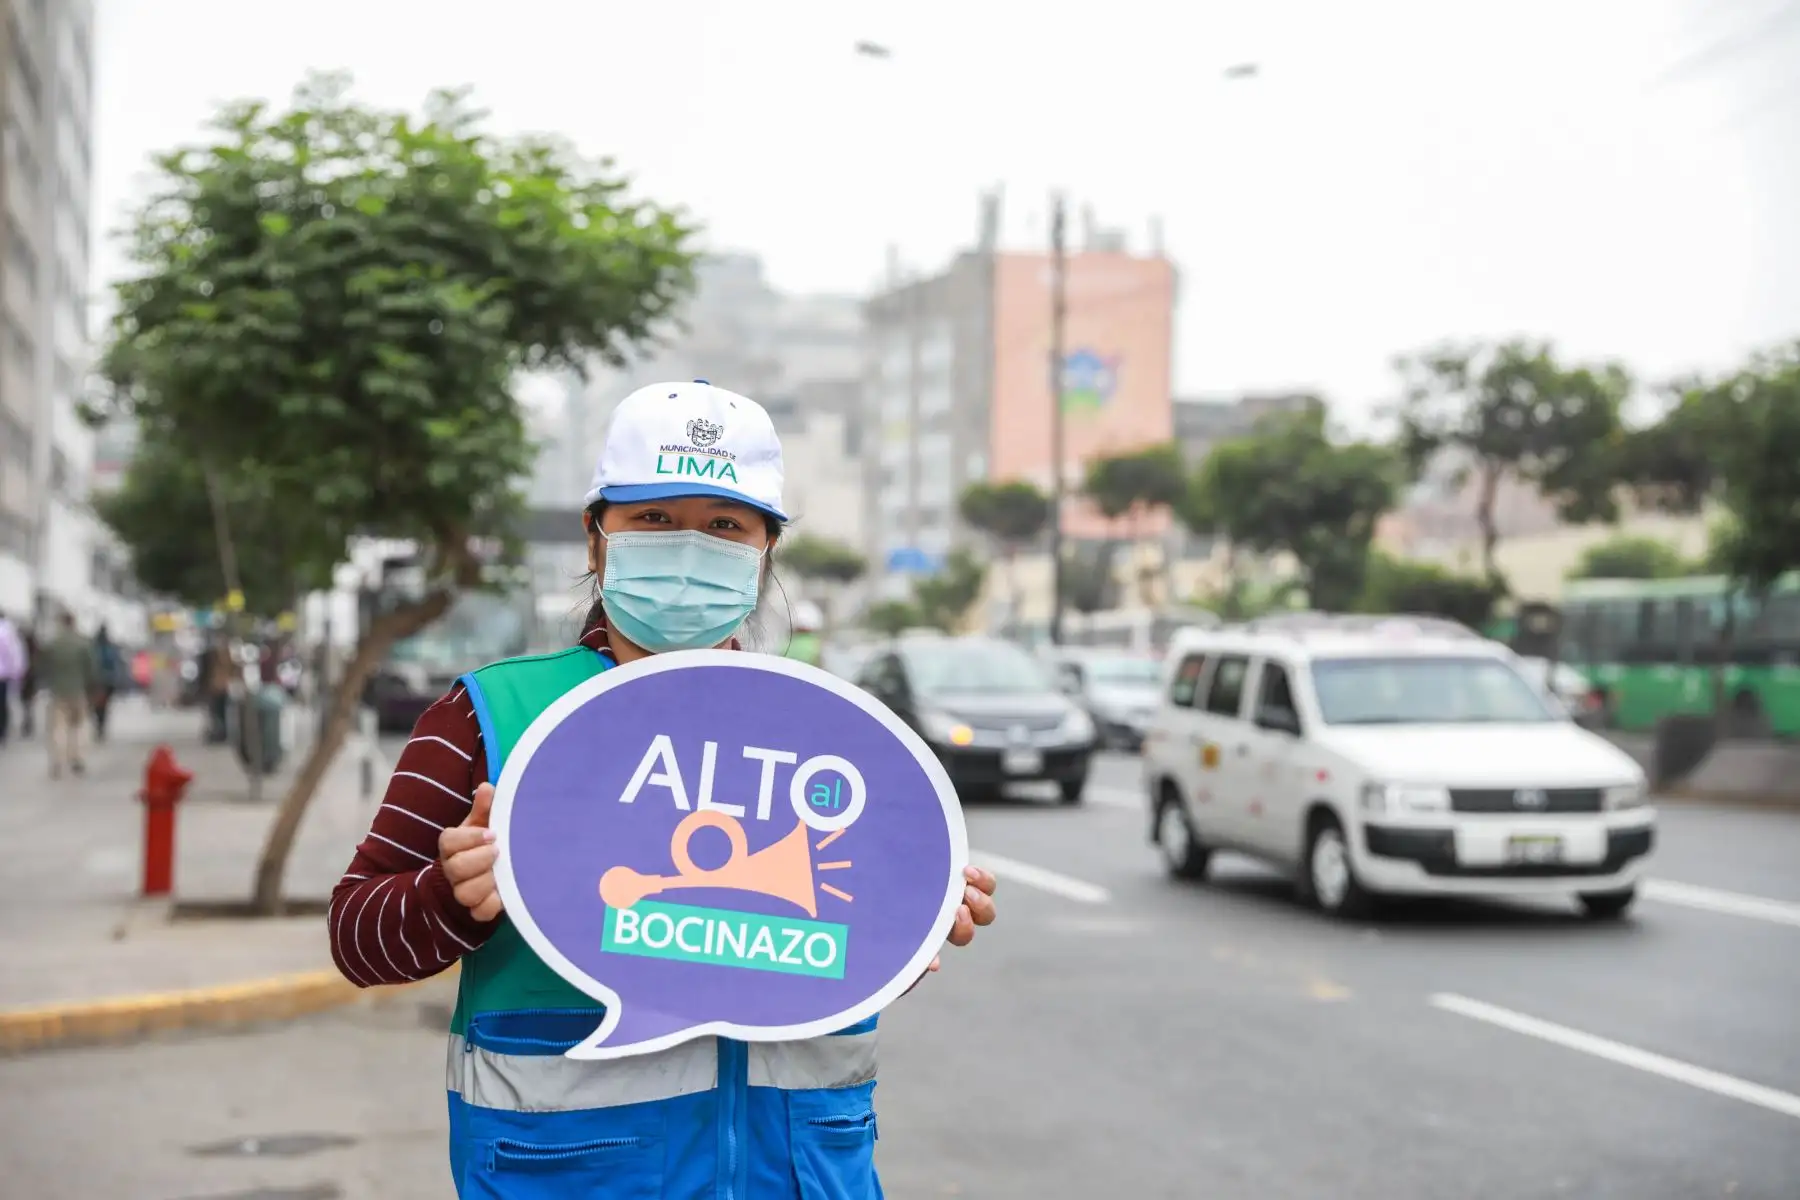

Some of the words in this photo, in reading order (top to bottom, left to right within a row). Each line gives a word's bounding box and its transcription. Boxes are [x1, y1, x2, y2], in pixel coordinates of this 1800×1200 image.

[656, 455, 737, 484] LIMA
[660, 445, 728, 457] MUNICIPALIDAD
[619, 734, 867, 832] ALTO
[811, 779, 842, 809] al
[614, 909, 837, 967] BOCINAZO
